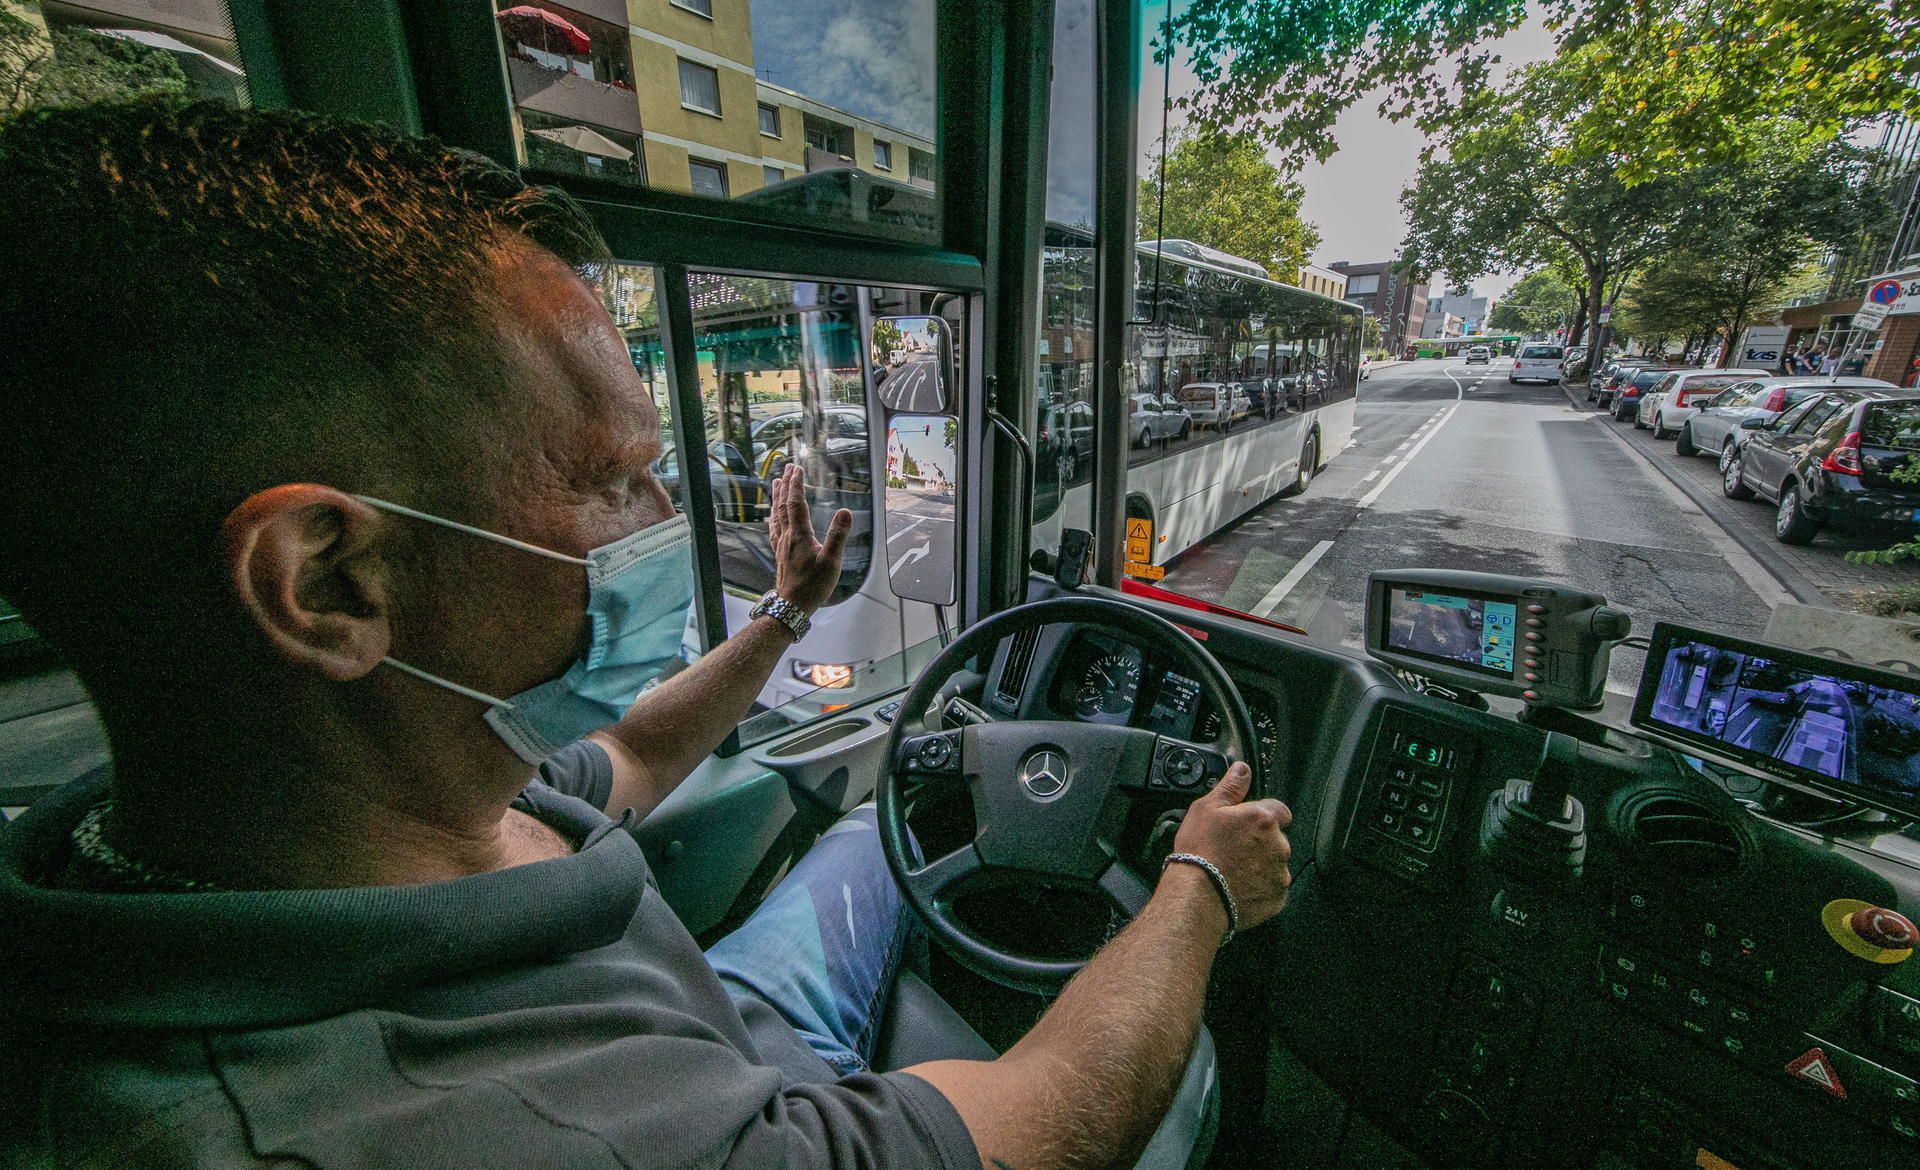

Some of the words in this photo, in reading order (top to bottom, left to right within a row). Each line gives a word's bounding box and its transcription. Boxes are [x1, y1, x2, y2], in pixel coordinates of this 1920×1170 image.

[1396, 769, 1405, 779] R
[1390, 791, 1400, 801] N
[1383, 814, 1393, 824] D
